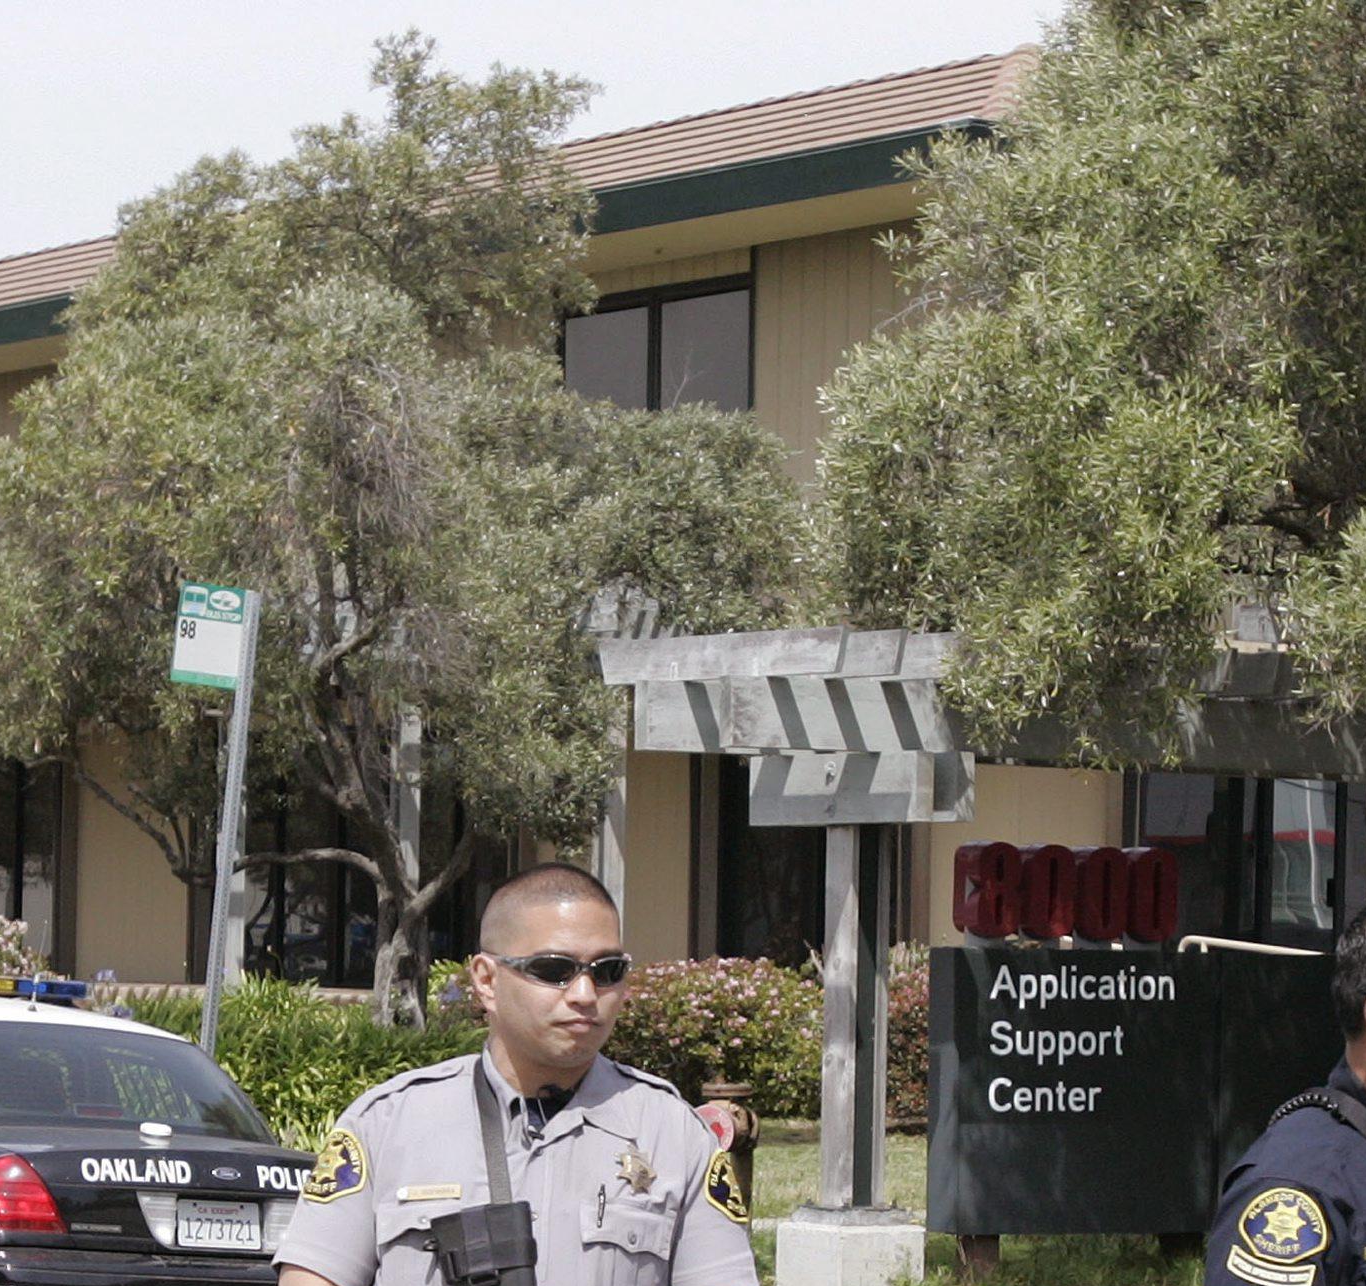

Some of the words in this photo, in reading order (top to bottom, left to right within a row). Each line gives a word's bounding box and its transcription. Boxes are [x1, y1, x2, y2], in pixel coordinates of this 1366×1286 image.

[180, 619, 197, 639] 98
[953, 842, 1179, 943] 8000
[989, 964, 1177, 1010] Application
[989, 1020, 1125, 1066] Support
[988, 1077, 1102, 1113] Center
[81, 1157, 192, 1184] OAKLAND
[257, 1165, 312, 1191] POLIC
[185, 1217, 255, 1243] 1273721
[1296, 1196, 1322, 1235] COUNTY
[1253, 1233, 1301, 1256] SHERIFF
